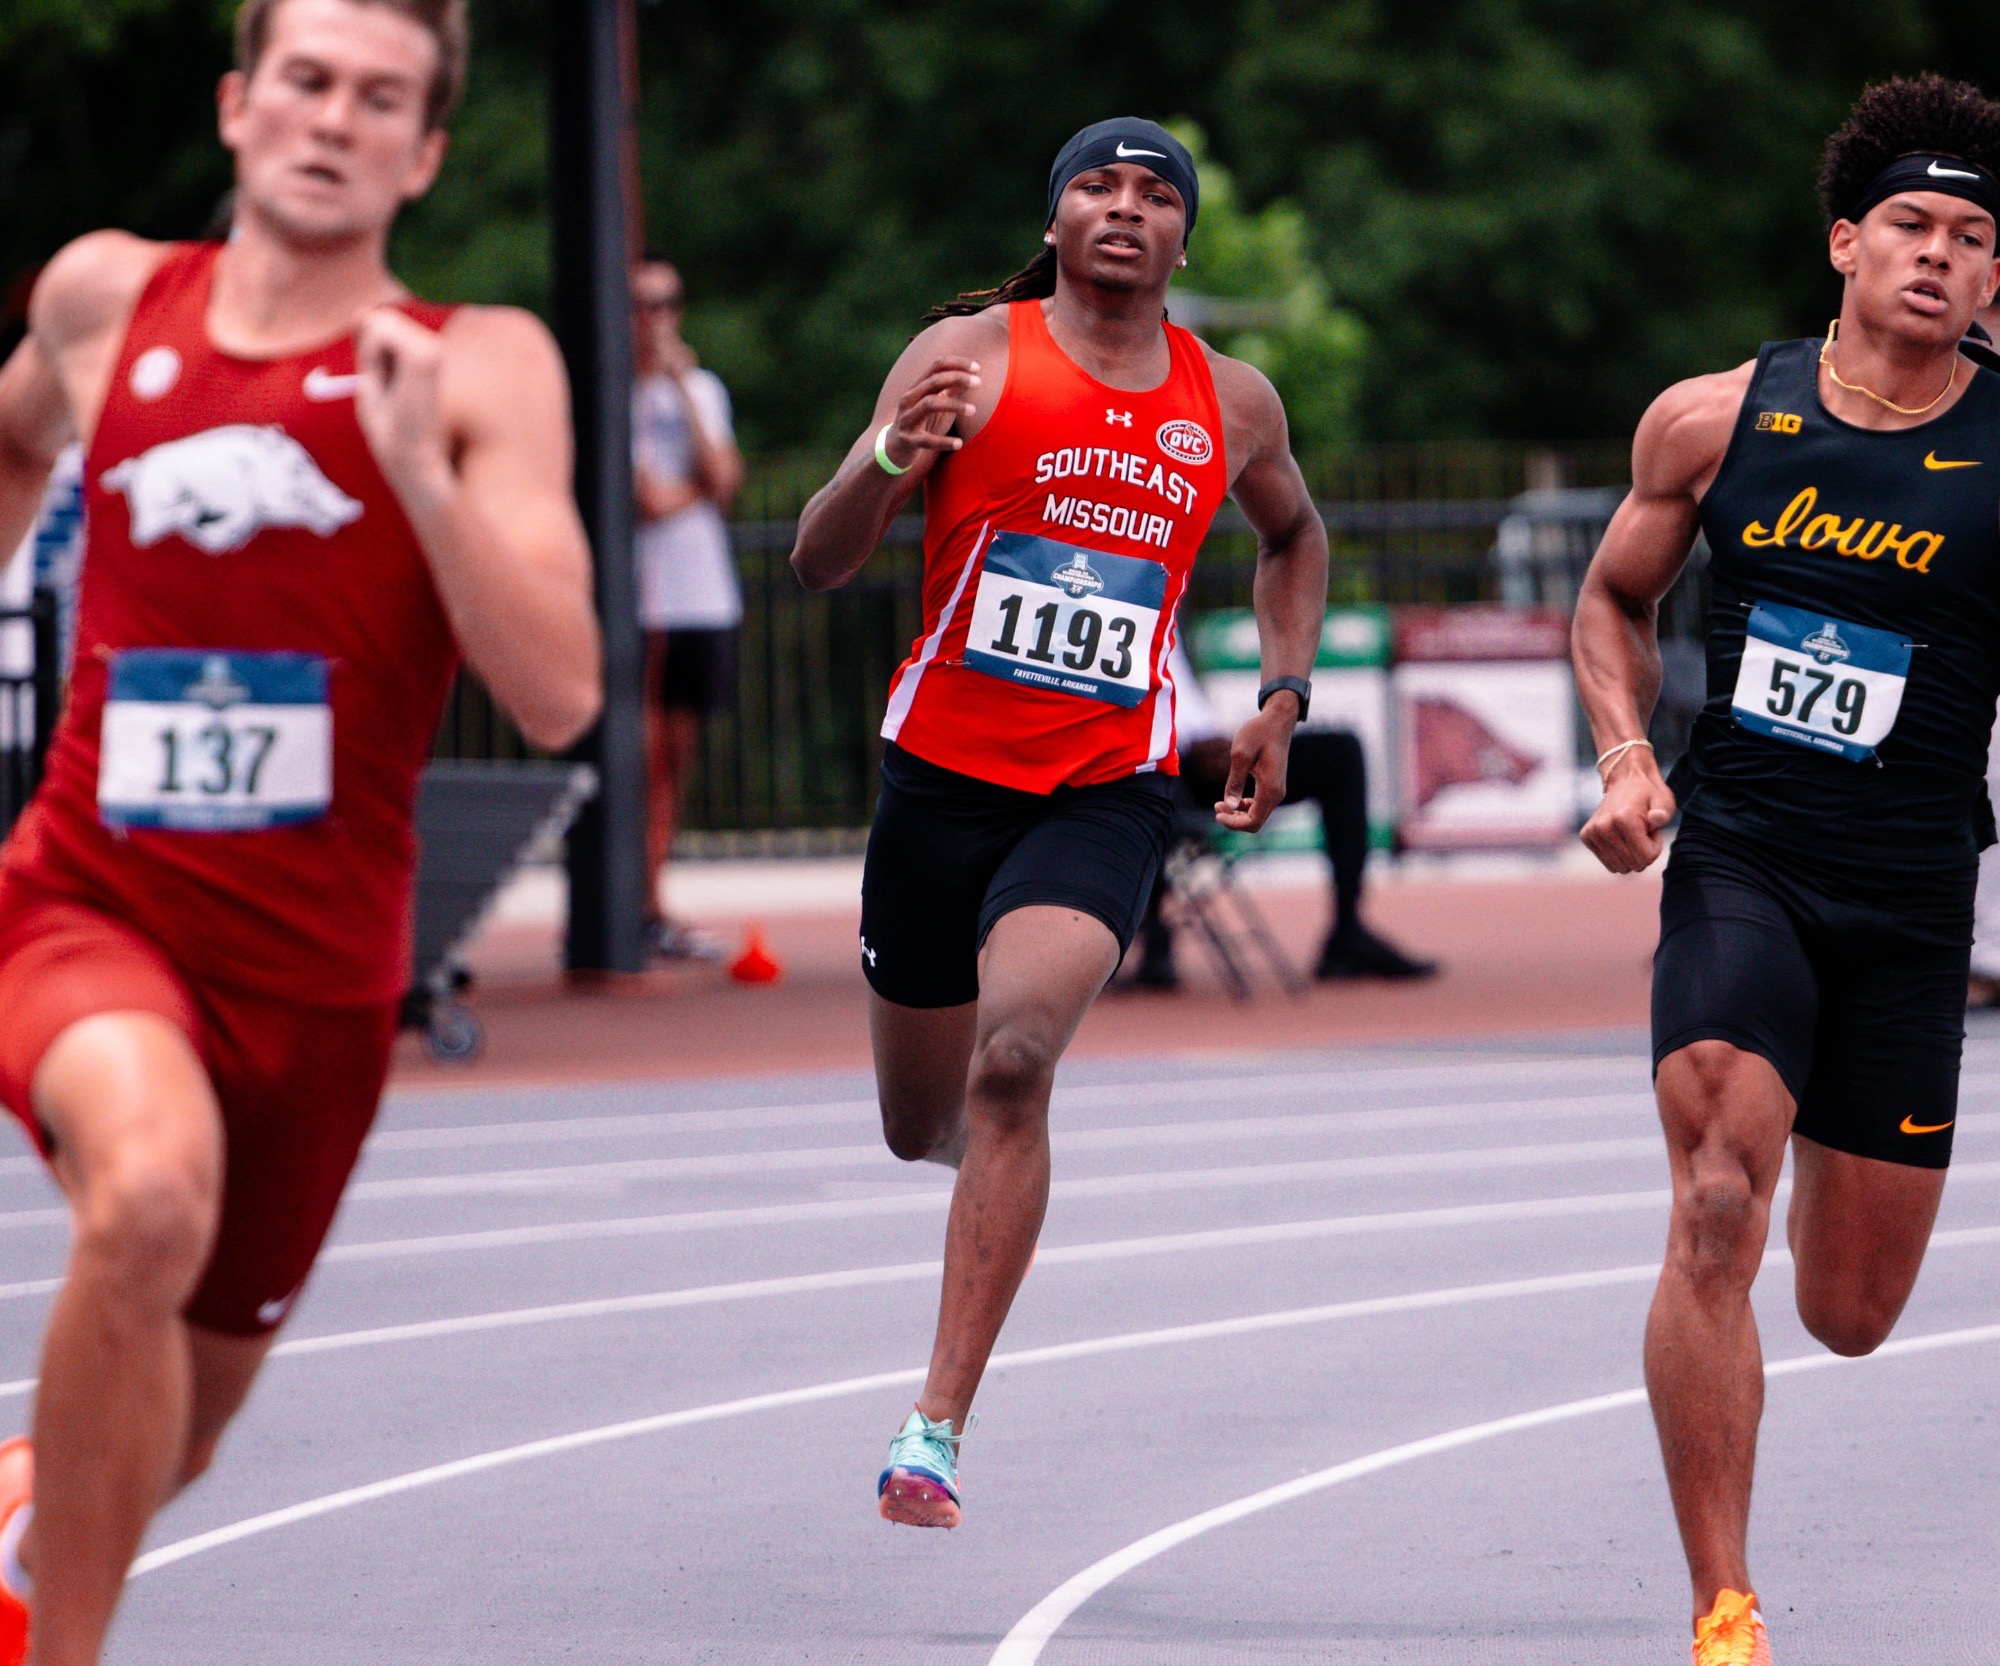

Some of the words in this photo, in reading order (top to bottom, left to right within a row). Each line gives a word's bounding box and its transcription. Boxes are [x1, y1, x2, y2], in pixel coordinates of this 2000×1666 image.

[1169, 431, 1203, 454] OVC
[1035, 447, 1198, 515] SOUTHEAST
[1042, 493, 1174, 548] MISSOURI
[1742, 486, 1945, 574] Iowa
[1053, 572, 1103, 589] CHAMPIONSHIPS
[991, 594, 1137, 679] 1193
[1013, 668, 1060, 686] FAYETTEVILLE,
[1060, 679, 1098, 693] ARKANSAS
[1766, 657, 1867, 735] 579
[158, 725, 278, 796] 137
